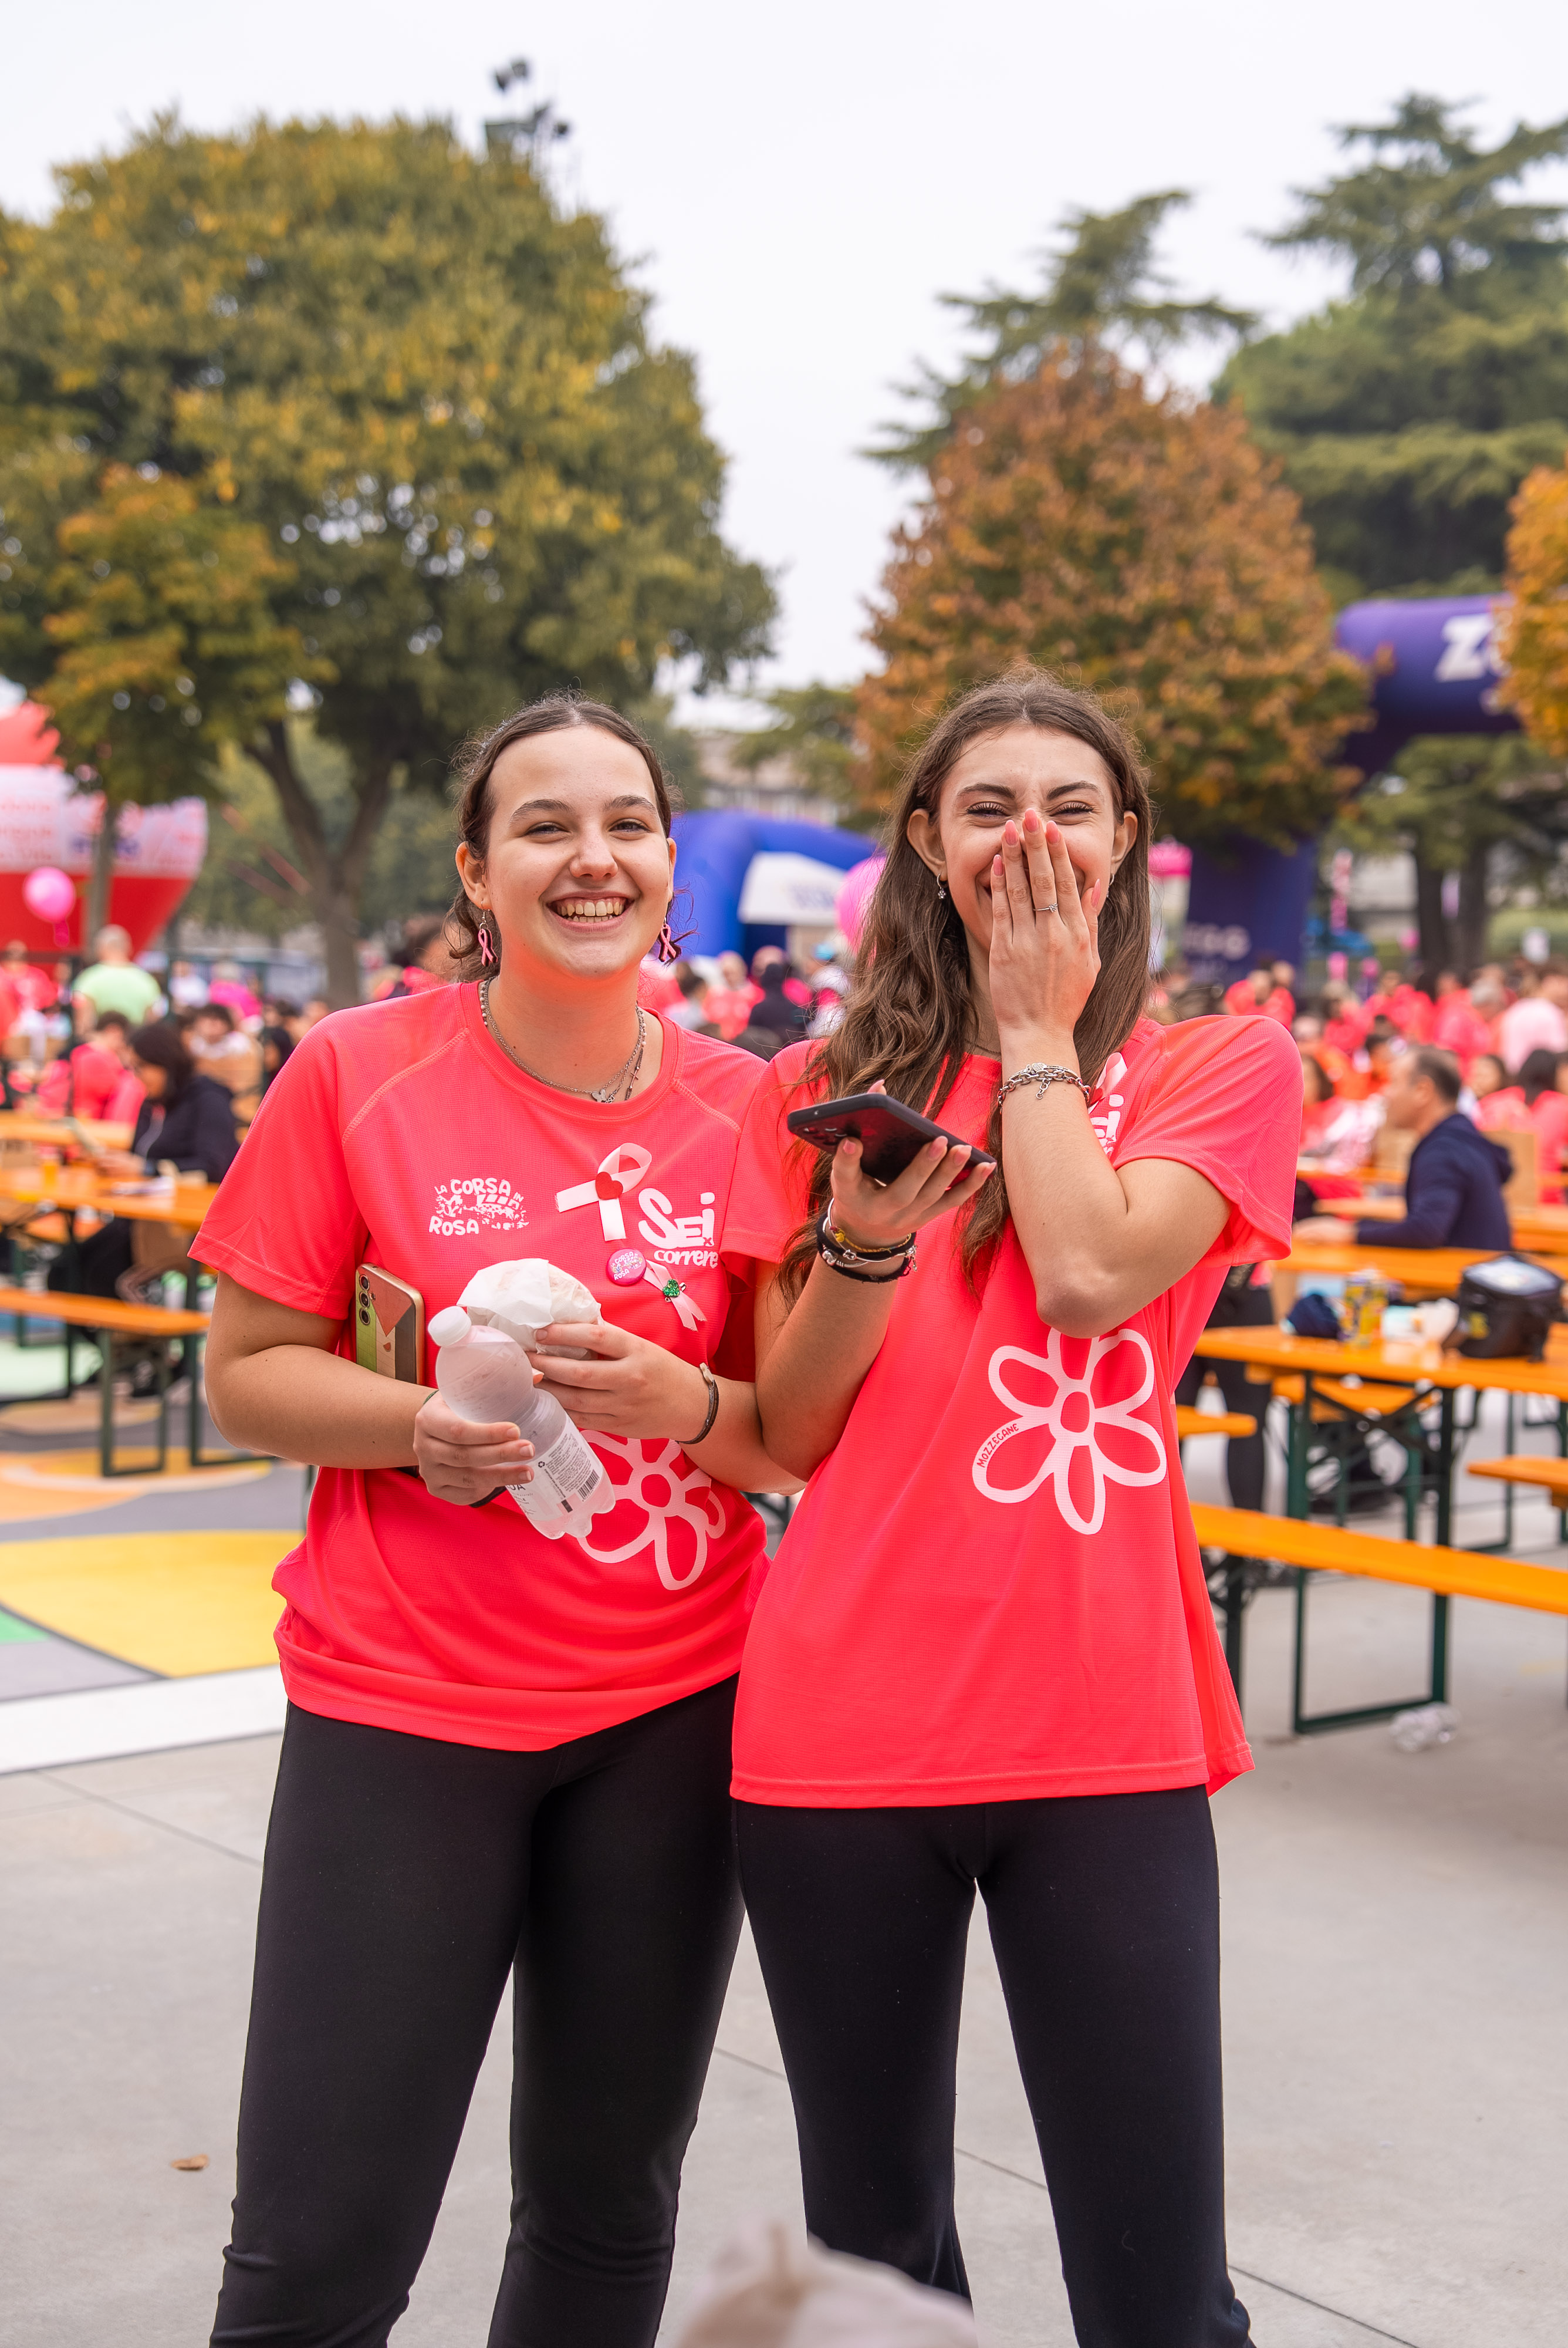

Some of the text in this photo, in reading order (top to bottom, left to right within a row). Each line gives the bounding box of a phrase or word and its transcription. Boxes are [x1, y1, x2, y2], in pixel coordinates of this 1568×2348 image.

[434, 1178, 524, 1202] LA CORSA IN
[429, 1216, 479, 1236] ROSA
[614, 1251, 634, 1264] CORSA
[654, 1250, 718, 1269] correre
[614, 1269, 630, 1280] ROSA
[976, 1423, 1019, 1468] MOZZECANE
